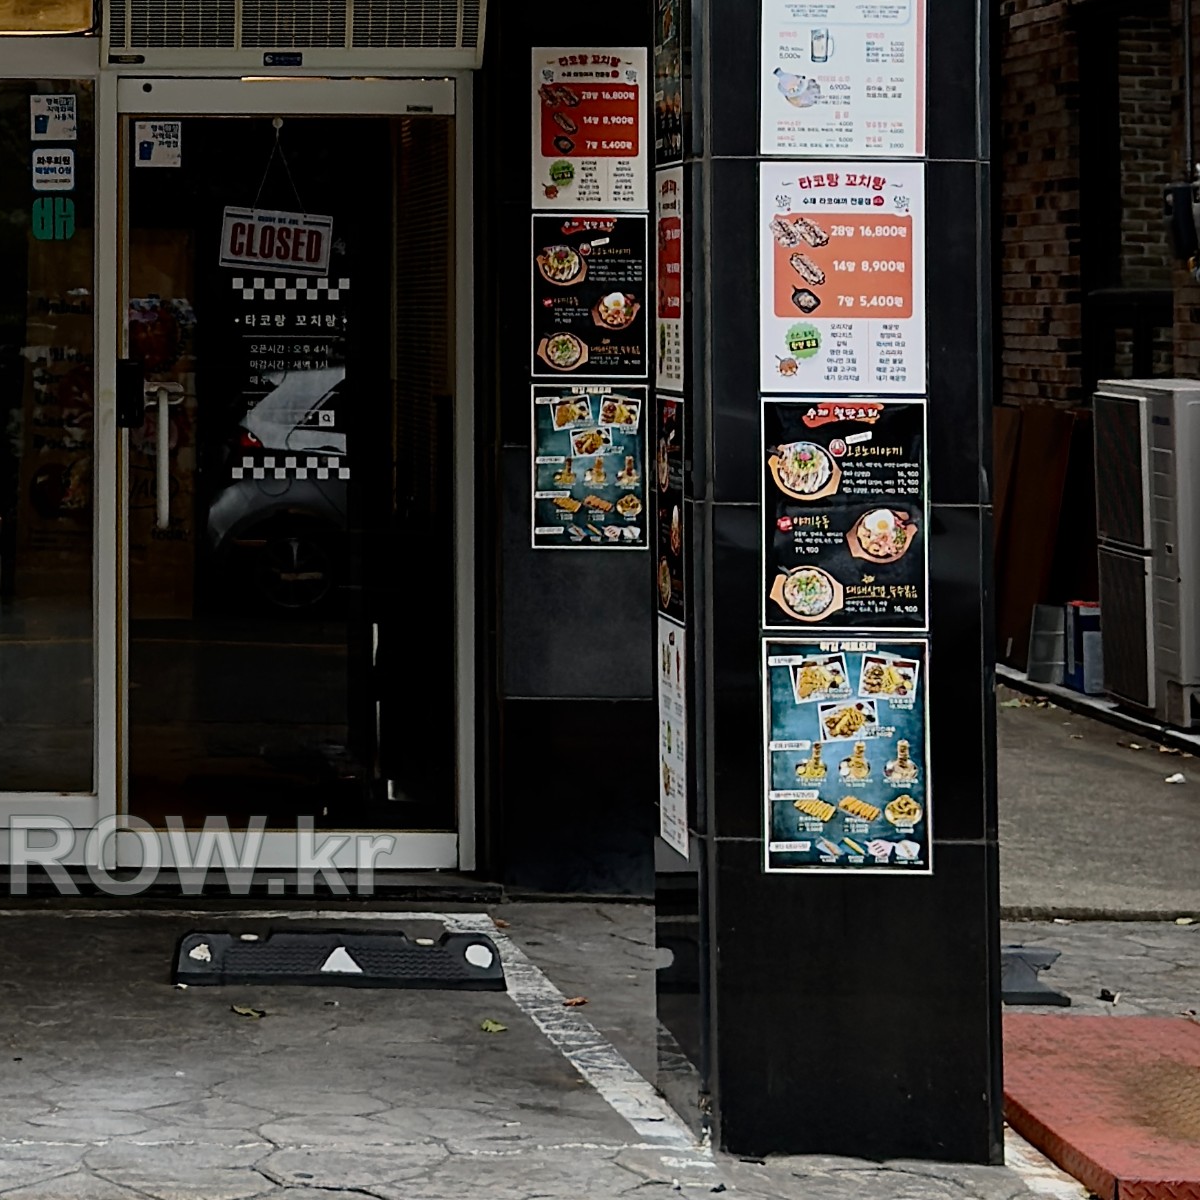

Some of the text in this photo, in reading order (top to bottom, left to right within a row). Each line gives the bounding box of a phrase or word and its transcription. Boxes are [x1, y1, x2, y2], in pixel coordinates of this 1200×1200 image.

[798, 173, 886, 191] 타코랑 꼬치랑
[859, 225, 907, 238] 16,800원
[230, 222, 322, 263] CLOSED
[861, 260, 905, 273] 8,900원
[859, 296, 904, 308] 5,400원
[244, 314, 337, 328] 타코랑 꼬치랑
[250, 344, 285, 354] 오픈시간
[293, 344, 311, 354] 오후
